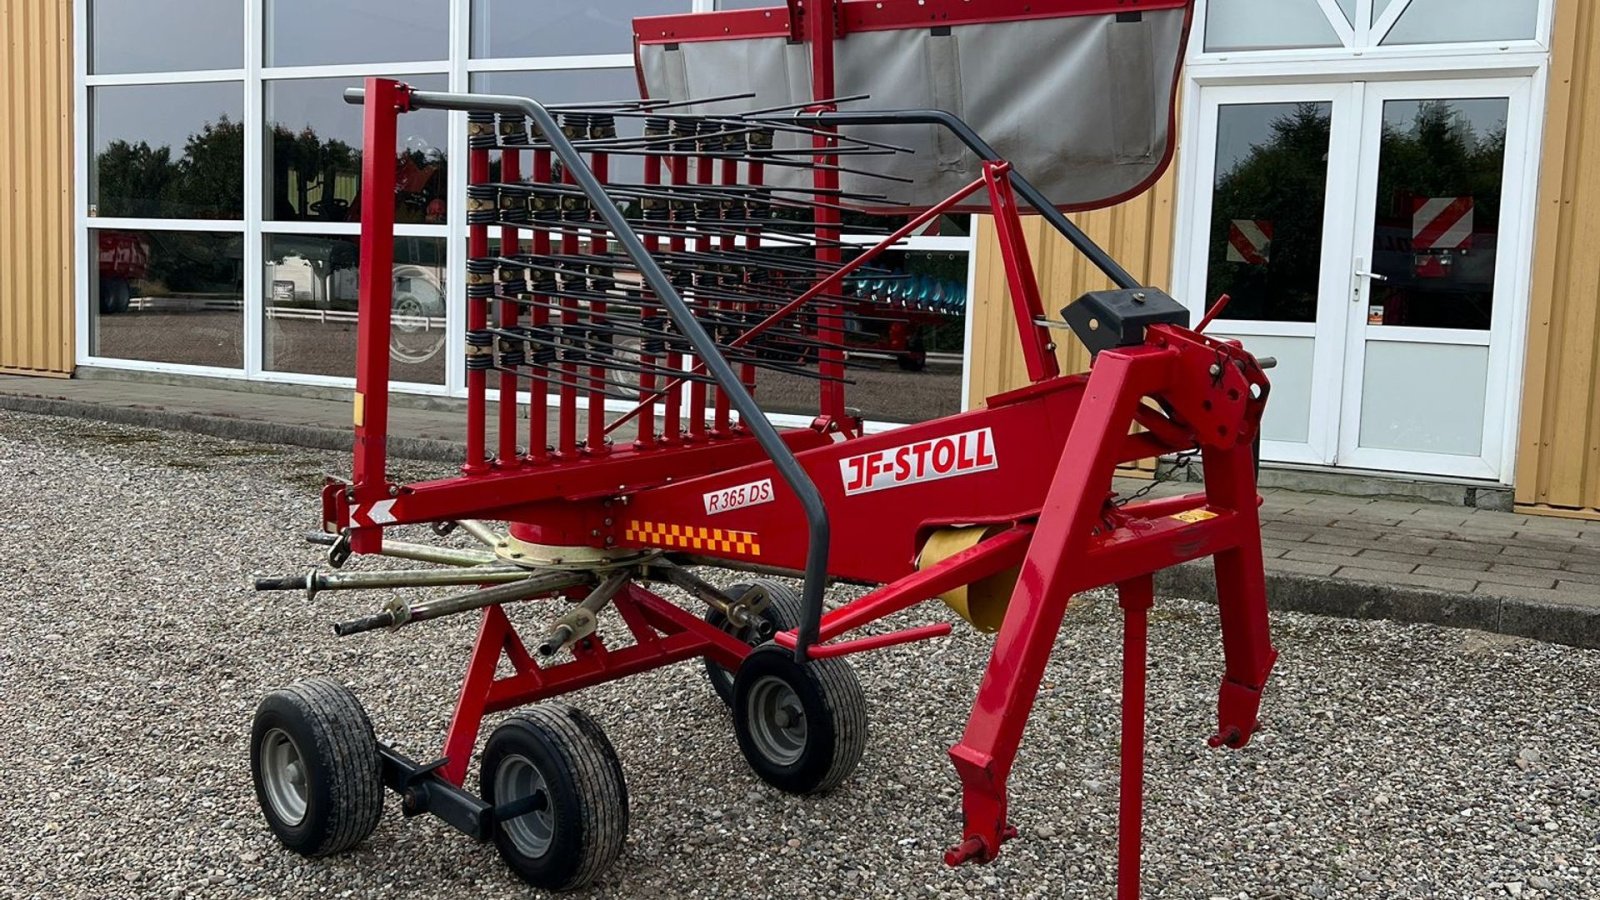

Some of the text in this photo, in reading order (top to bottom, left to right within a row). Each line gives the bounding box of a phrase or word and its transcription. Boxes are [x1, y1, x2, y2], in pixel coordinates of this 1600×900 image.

[847, 430, 993, 490] JF-STOLL
[709, 482, 770, 512] R 365 DS
